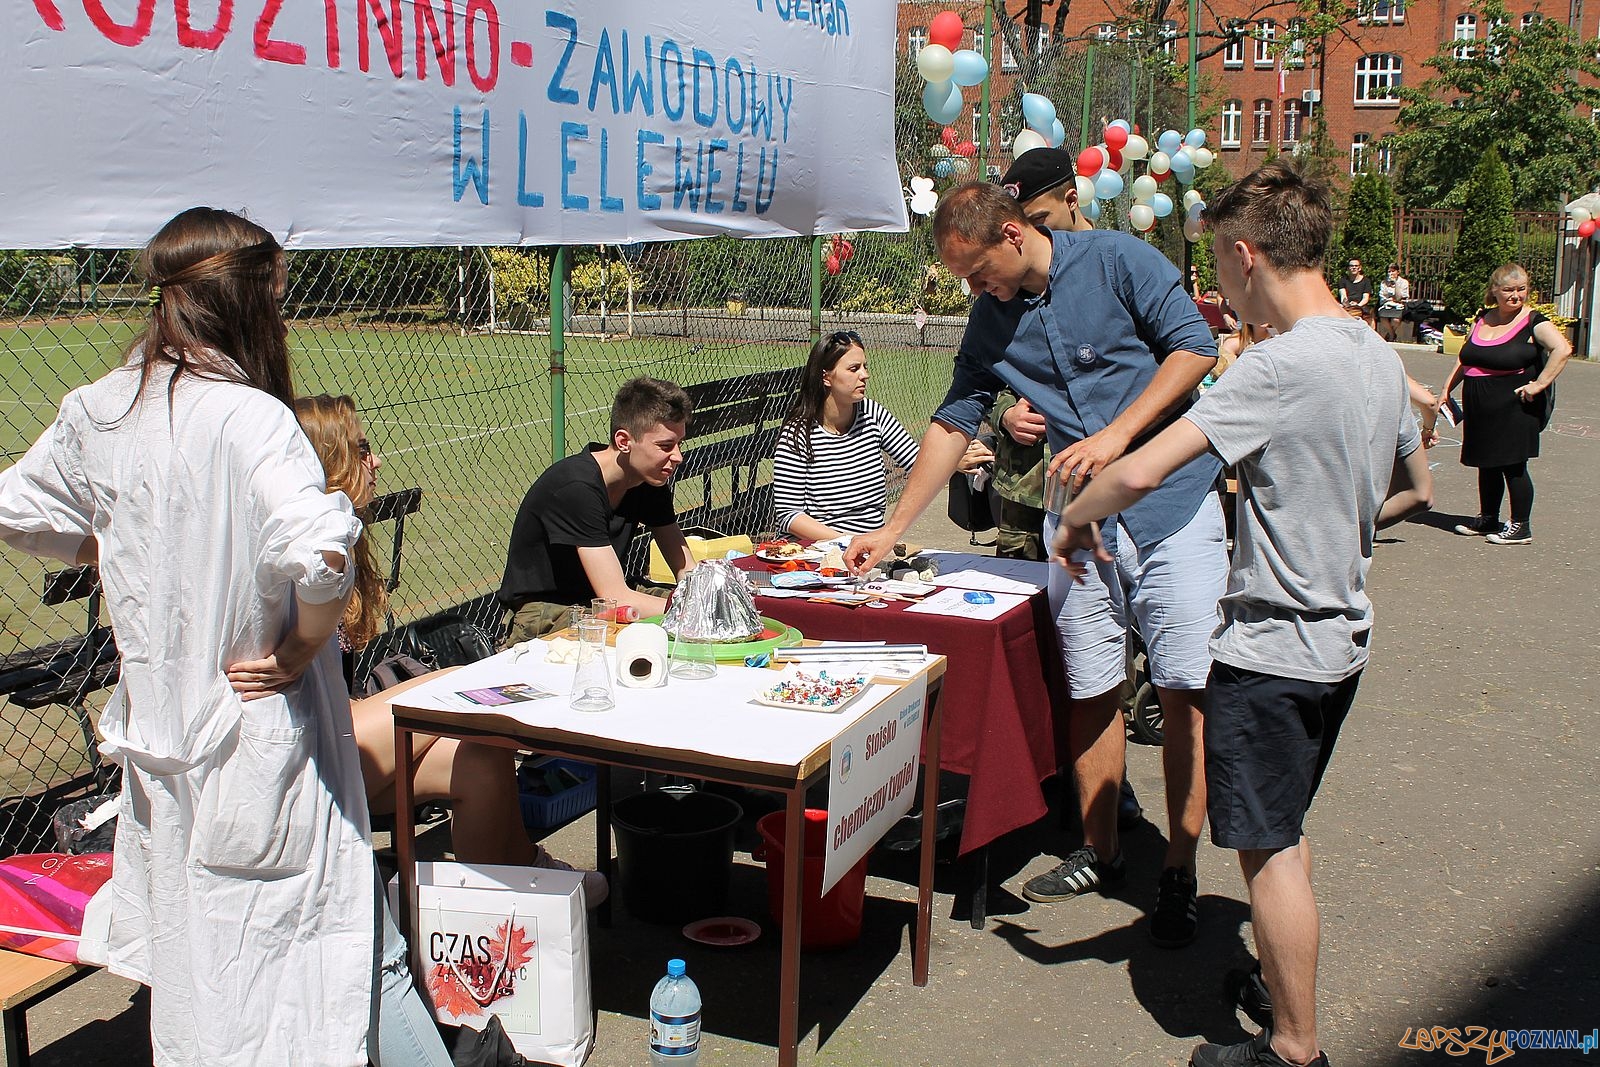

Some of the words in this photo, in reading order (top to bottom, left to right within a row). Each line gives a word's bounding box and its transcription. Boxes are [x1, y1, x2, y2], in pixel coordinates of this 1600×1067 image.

[545, 10, 794, 144] ZAWODOWY
[453, 104, 490, 206] W
[517, 109, 779, 215] LELEWELU
[865, 719, 897, 761] Stoisko
[833, 783, 889, 851] chemiczny
[887, 755, 916, 802] tygiel
[430, 931, 492, 965] CZAS
